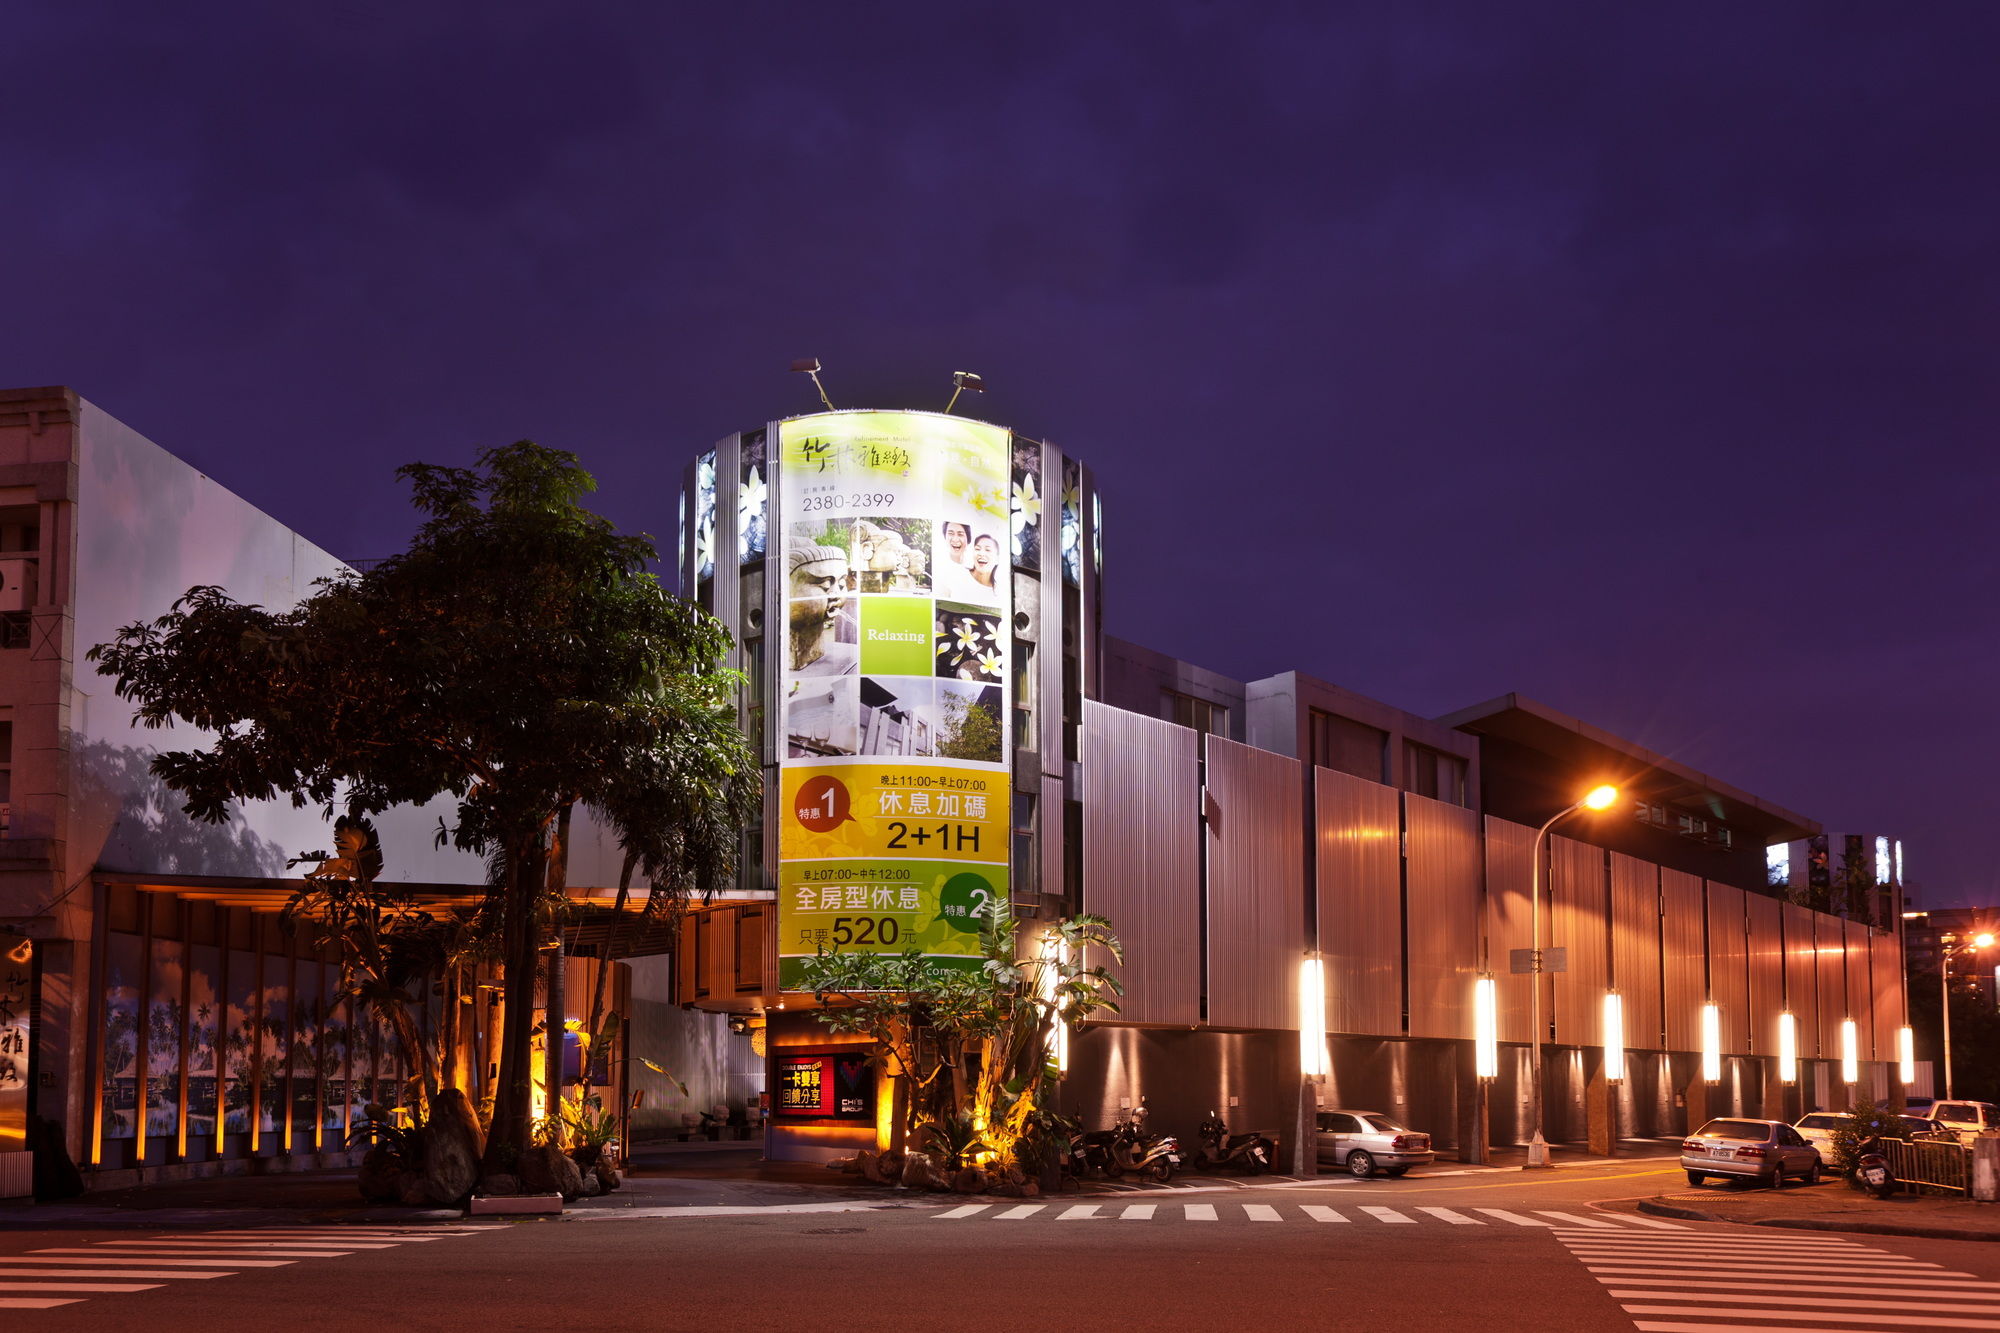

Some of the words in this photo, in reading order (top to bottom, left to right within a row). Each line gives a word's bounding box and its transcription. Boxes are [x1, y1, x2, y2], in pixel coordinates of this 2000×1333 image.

[803, 493, 895, 511] 2380-2399
[867, 628, 926, 645] Relaxing
[798, 807, 821, 820] 特惠
[879, 790, 987, 819] 休息加碼
[887, 822, 980, 852] 2+1H
[795, 885, 921, 910] 全房型休息
[944, 904, 967, 917] 特惠
